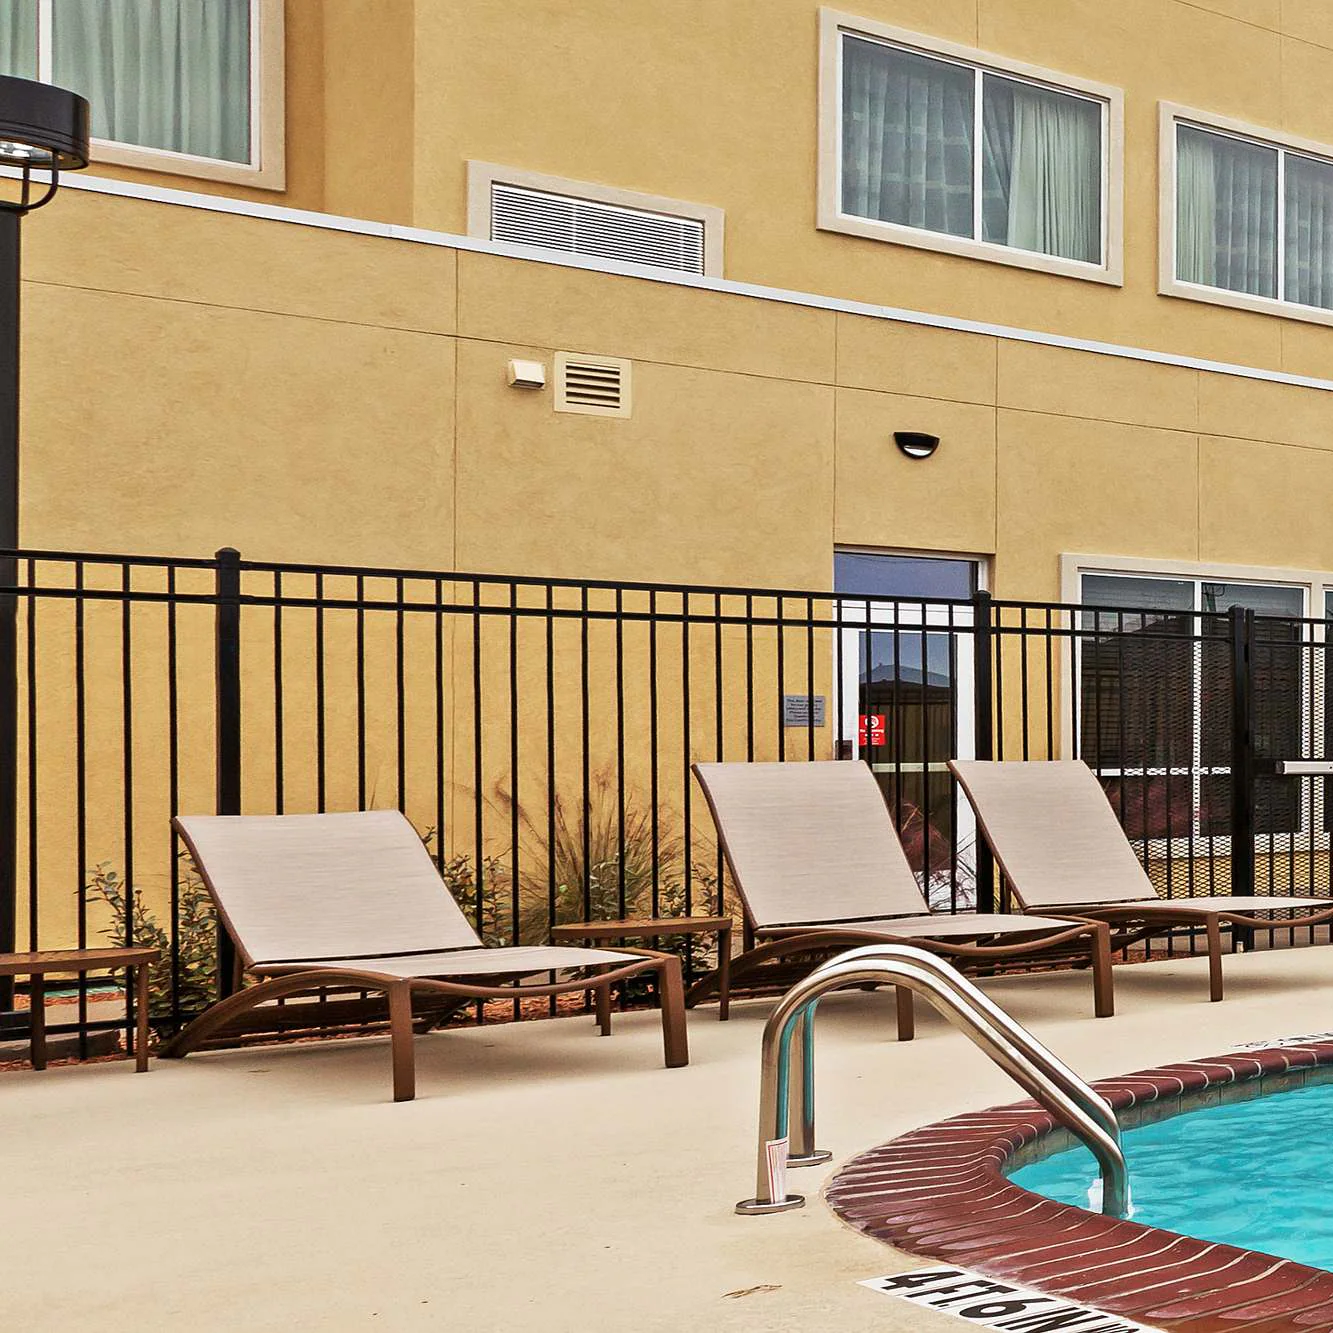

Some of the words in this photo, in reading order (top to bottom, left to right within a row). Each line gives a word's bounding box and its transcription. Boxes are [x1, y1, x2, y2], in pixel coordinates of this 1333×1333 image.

[880, 1270, 966, 1291] 4
[959, 1297, 1057, 1319] 6
[993, 1306, 1109, 1333] IN
